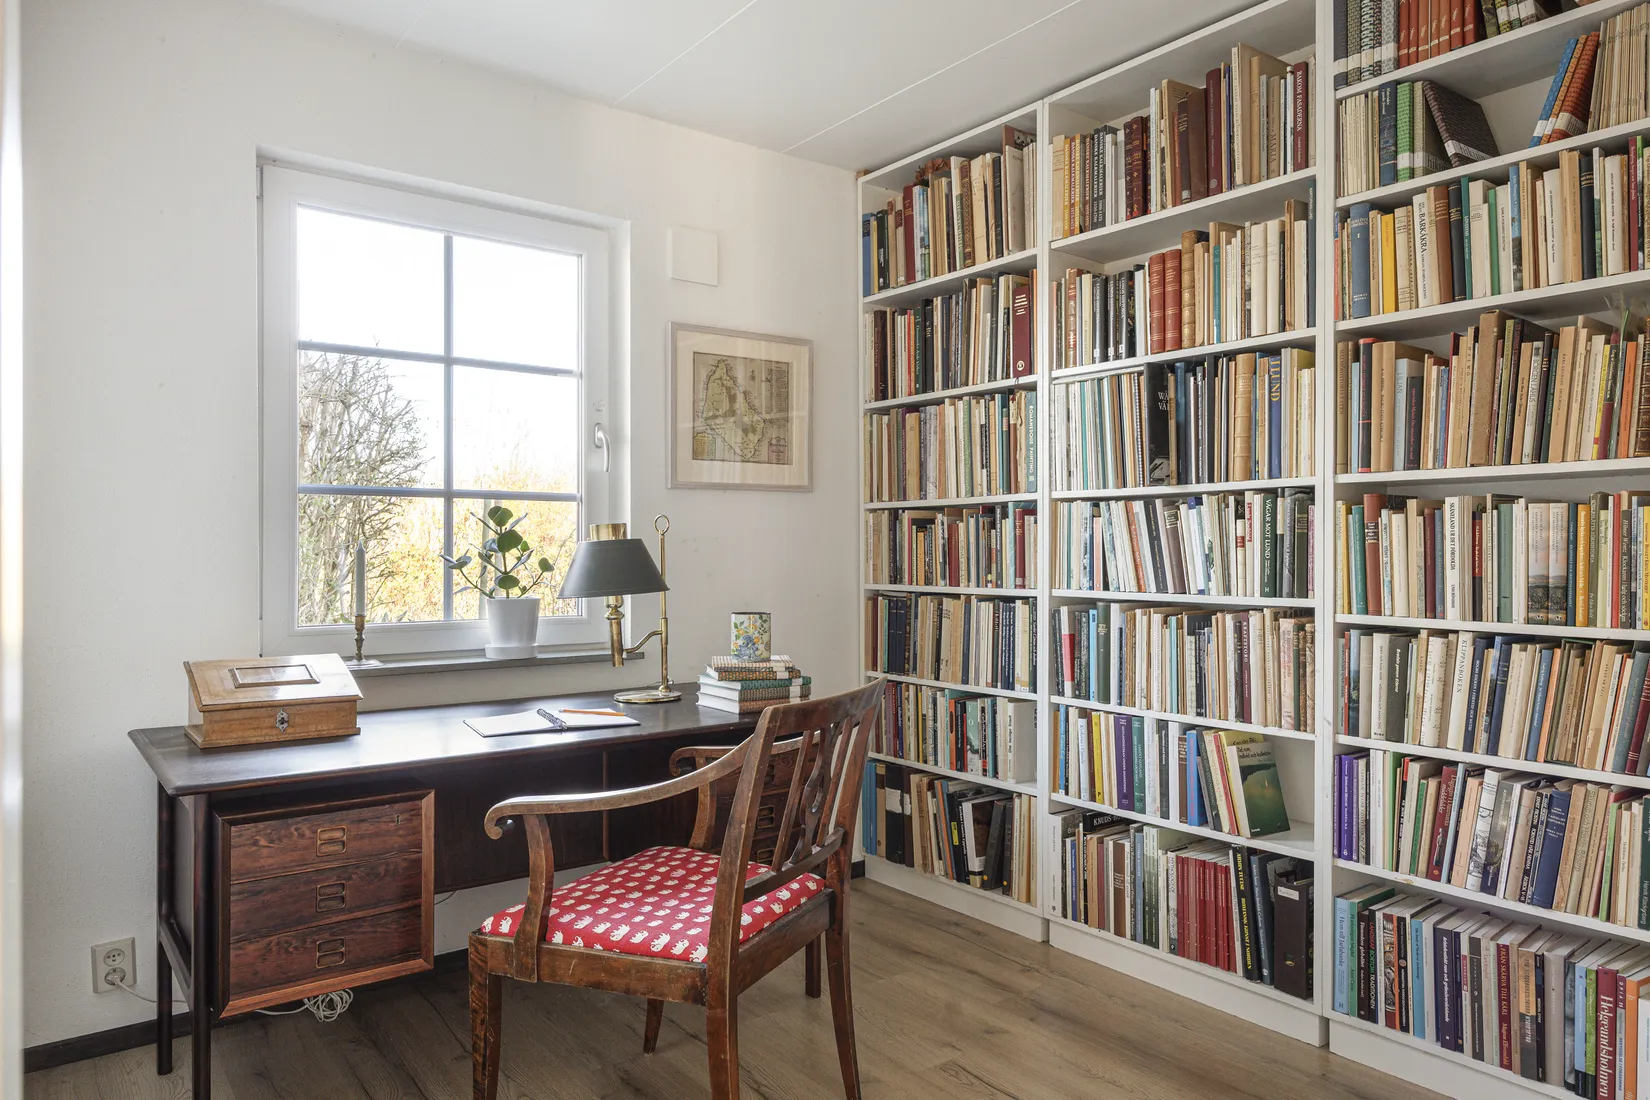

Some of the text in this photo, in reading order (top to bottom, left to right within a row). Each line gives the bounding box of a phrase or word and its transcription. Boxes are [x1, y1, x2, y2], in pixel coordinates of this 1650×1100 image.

[1419, 213, 1428, 253] BARKÅKRA
[1270, 367, 1280, 401] LUND
[1456, 640, 1468, 693] KLIPPANBOKEN
[1500, 948, 1508, 964] FRÅN
[1500, 965, 1508, 987] SKÄRVA
[1501, 1000, 1509, 1015] KÄRL
[1597, 994, 1614, 1096] Helgeandsholmen
